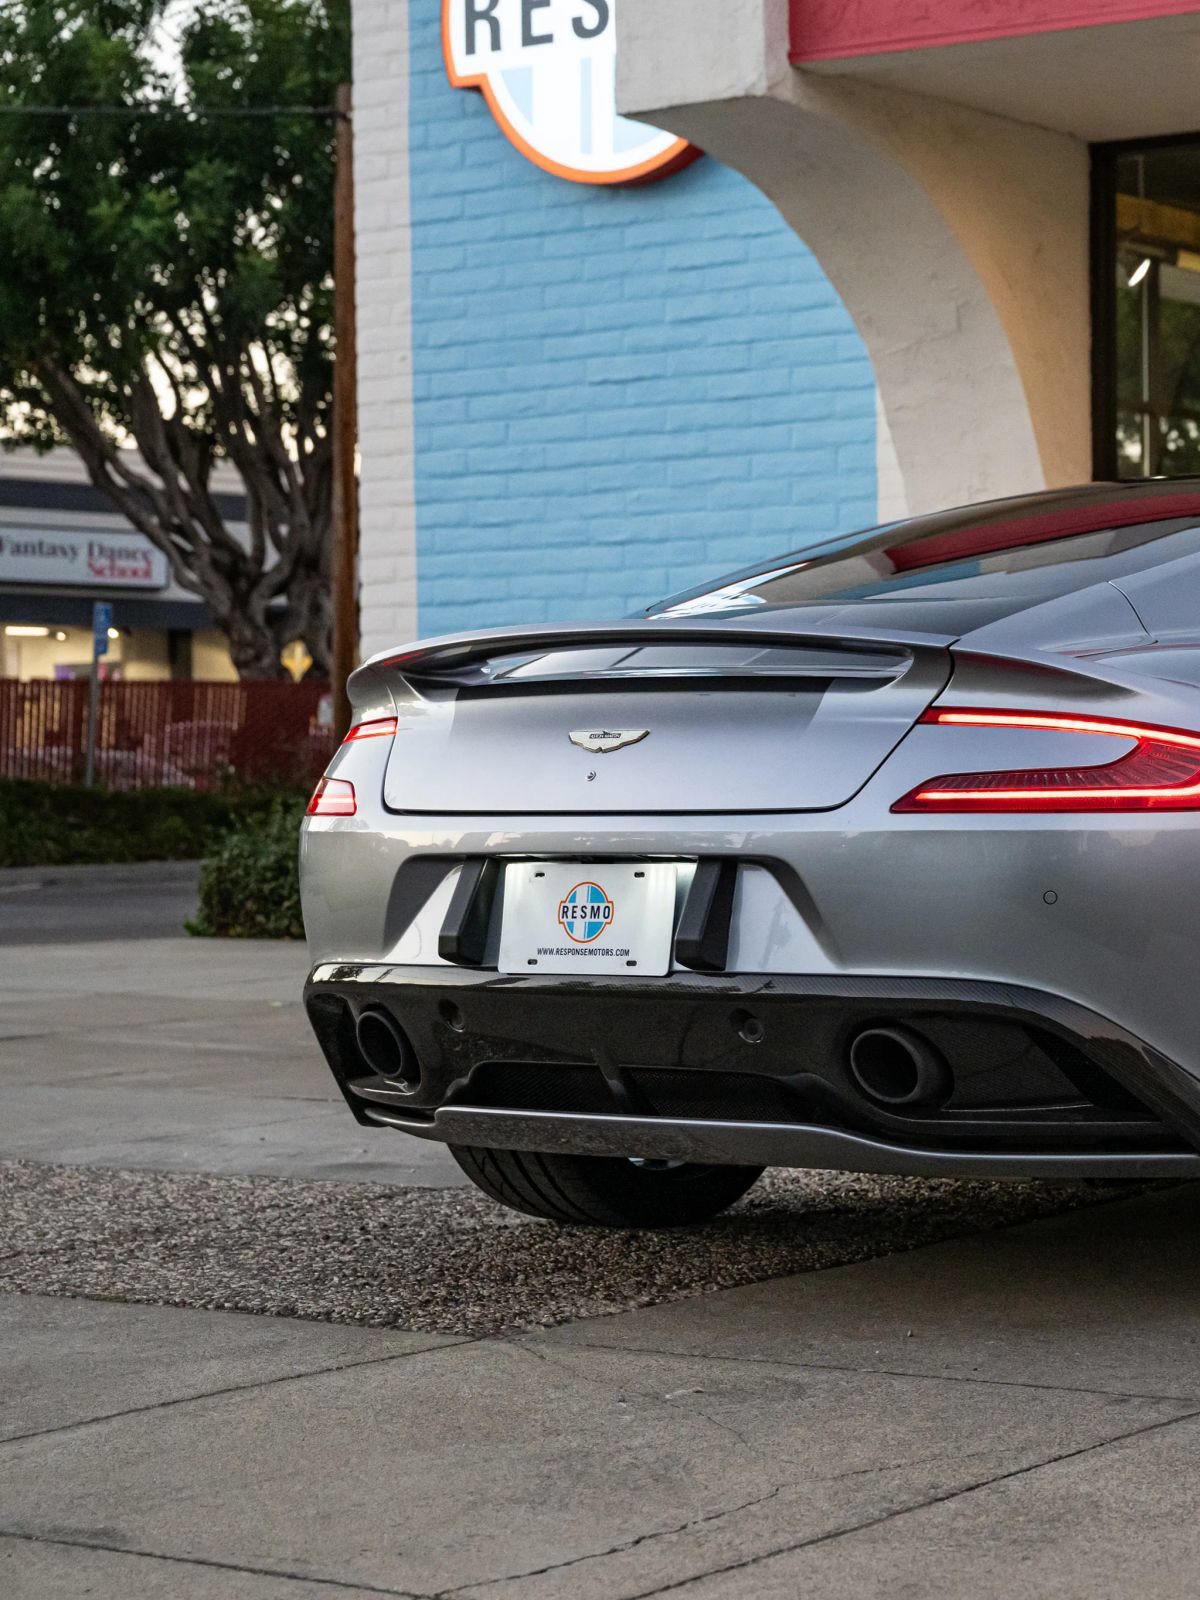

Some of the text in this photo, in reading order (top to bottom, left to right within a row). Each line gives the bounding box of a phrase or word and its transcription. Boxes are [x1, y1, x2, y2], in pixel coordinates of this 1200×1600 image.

[464, 0, 609, 55] RES
[561, 905, 611, 920] RESMO
[537, 947, 630, 957] WWW.RESPONSEMOTORS.COM
